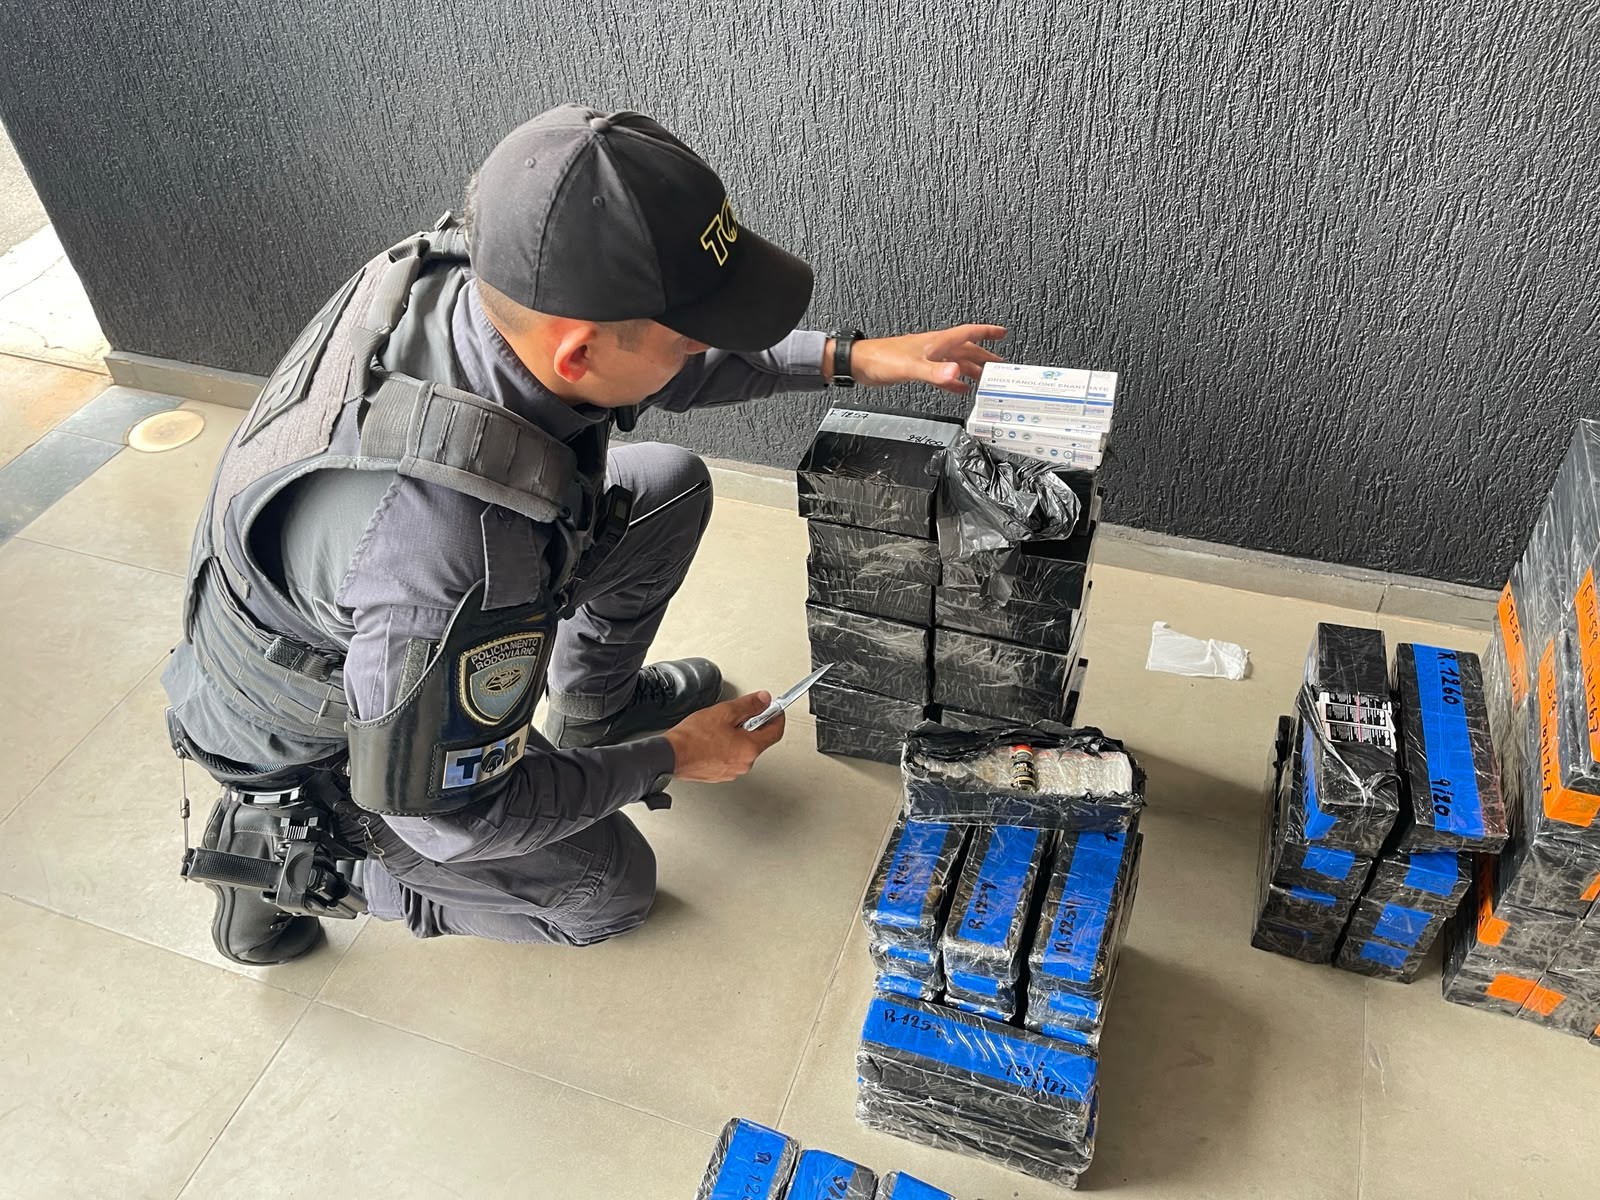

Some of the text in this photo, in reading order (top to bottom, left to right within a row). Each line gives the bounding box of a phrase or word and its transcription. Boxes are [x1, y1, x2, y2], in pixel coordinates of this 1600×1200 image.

[700, 199, 738, 267] TO
[471, 637, 539, 665] POLICIAMENTO
[456, 736, 520, 780] TOR
